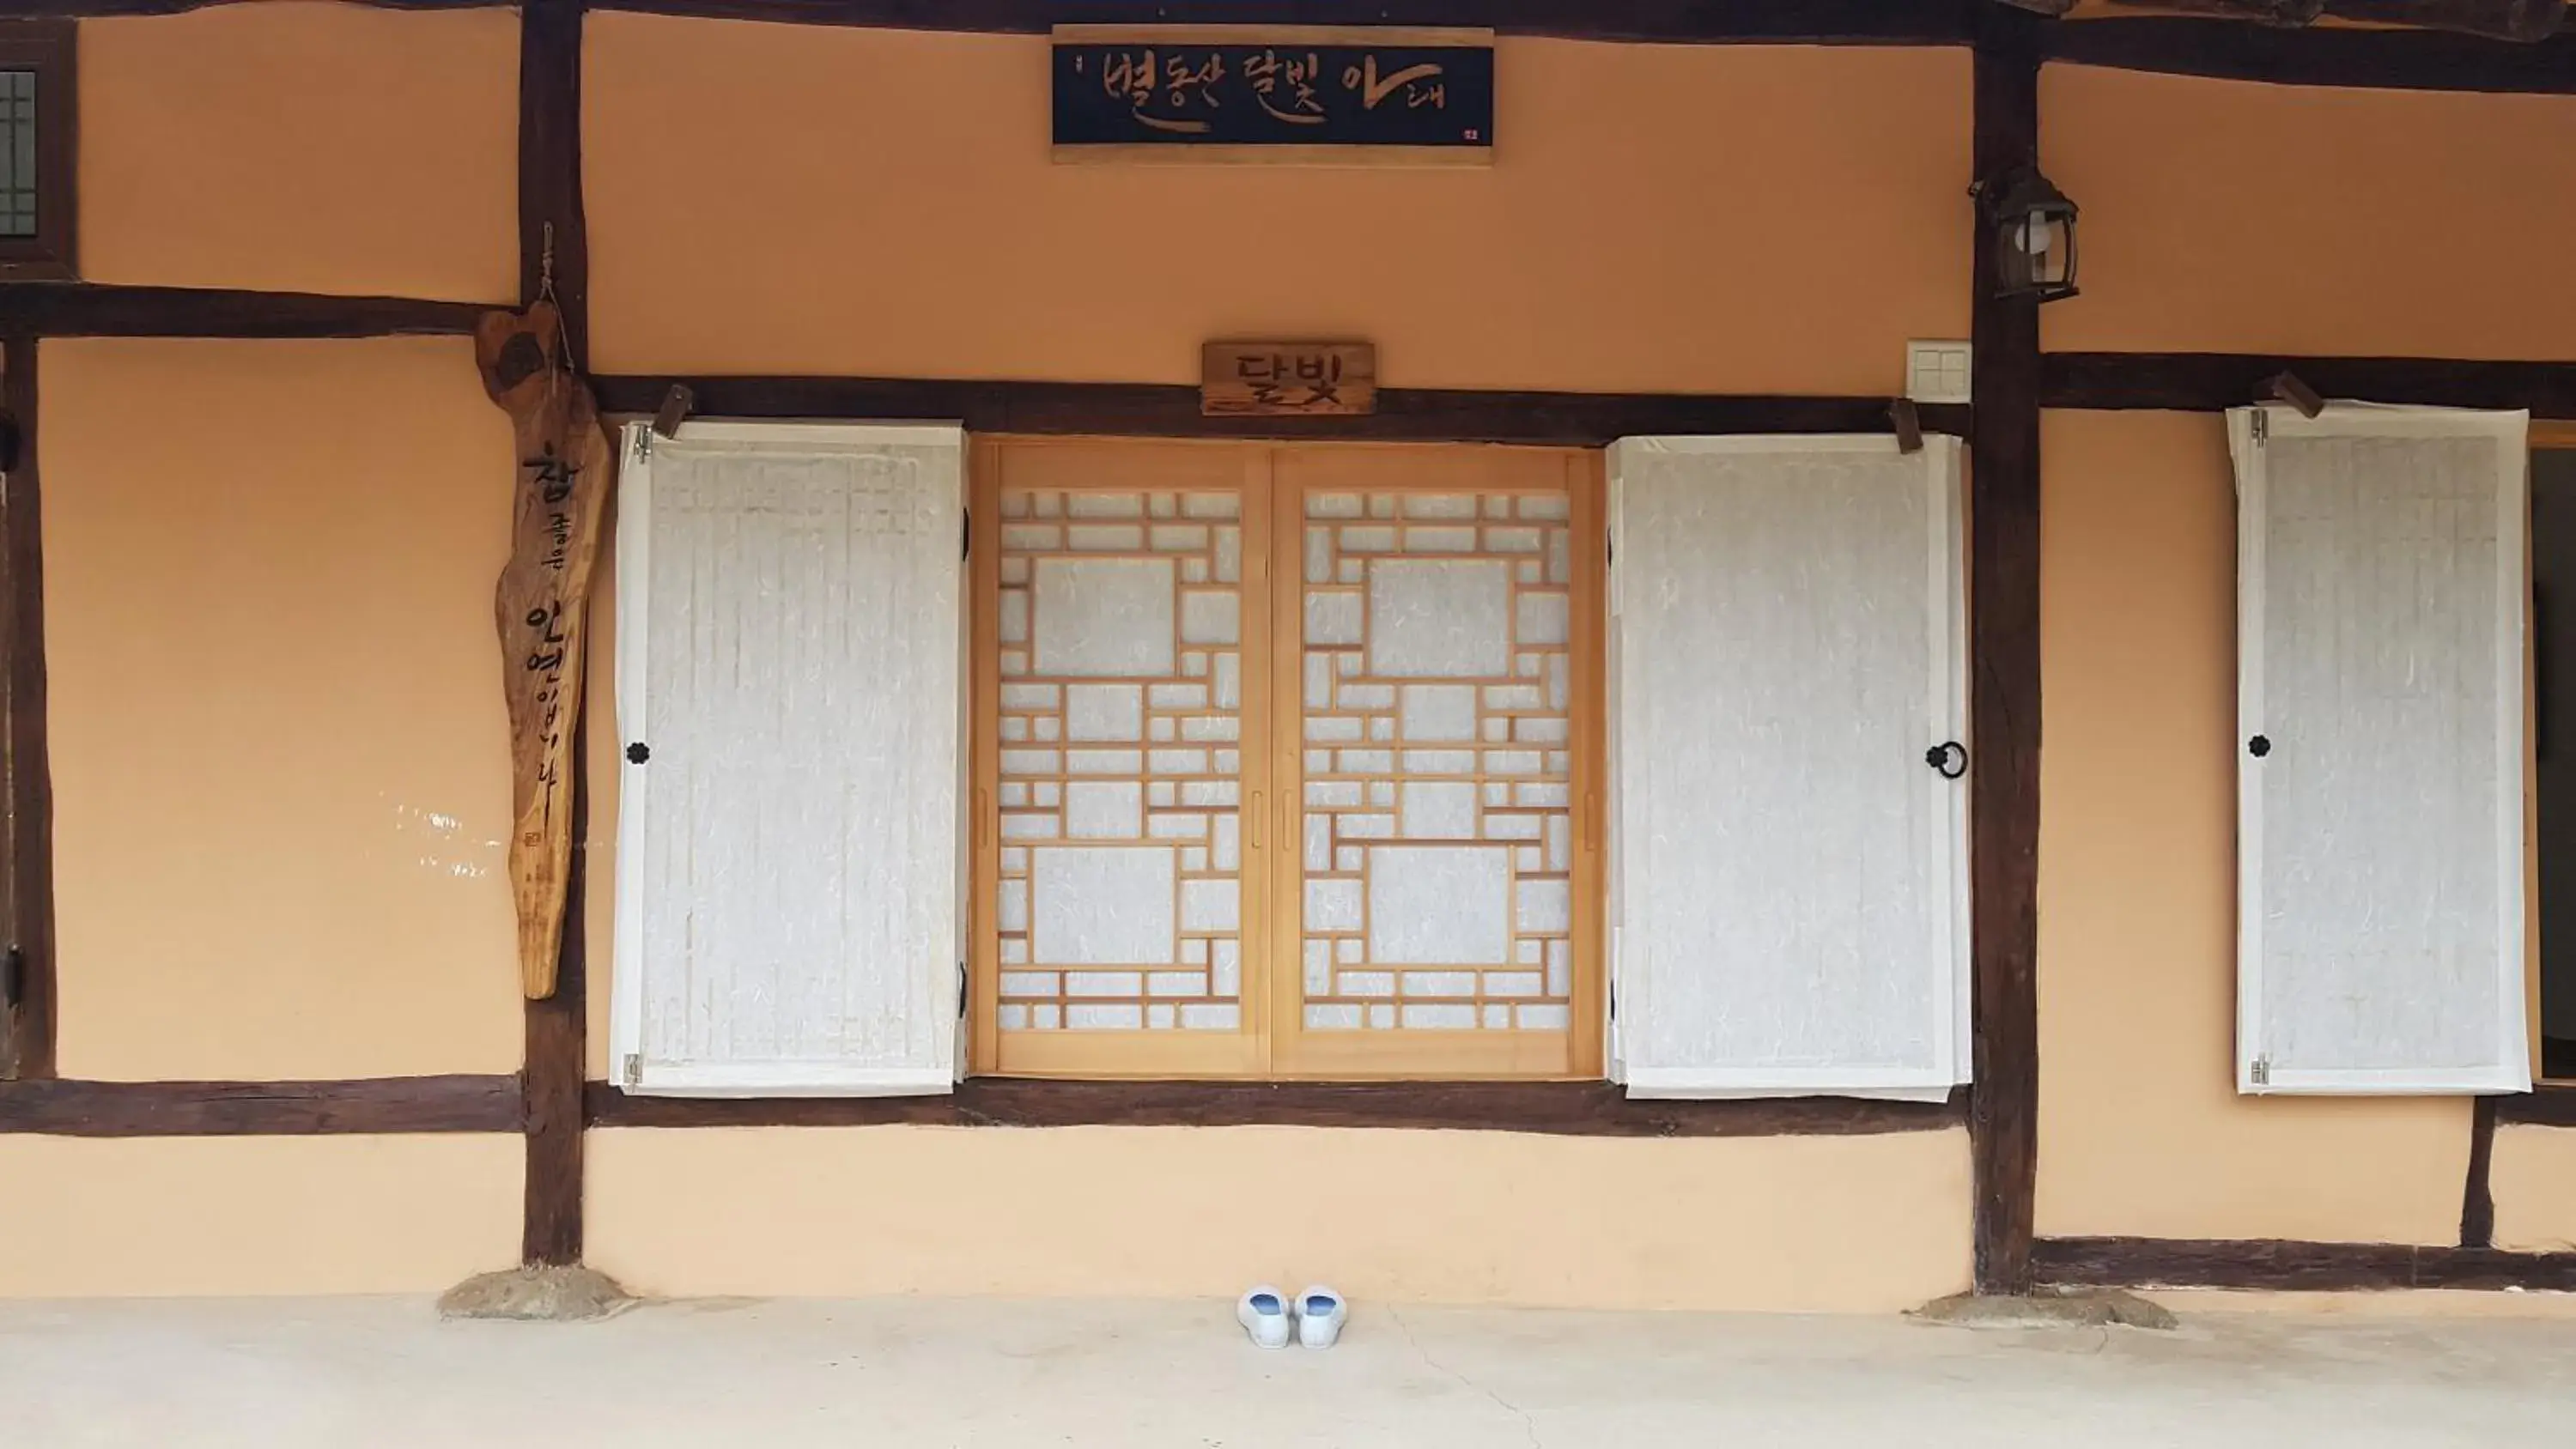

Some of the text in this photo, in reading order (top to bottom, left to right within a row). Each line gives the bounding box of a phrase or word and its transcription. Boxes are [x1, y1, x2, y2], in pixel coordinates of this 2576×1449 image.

[1242, 49, 1328, 123] 달빛
[1342, 53, 1445, 111] 아래
[1236, 353, 1342, 407] 달빛
[522, 440, 580, 504] 참
